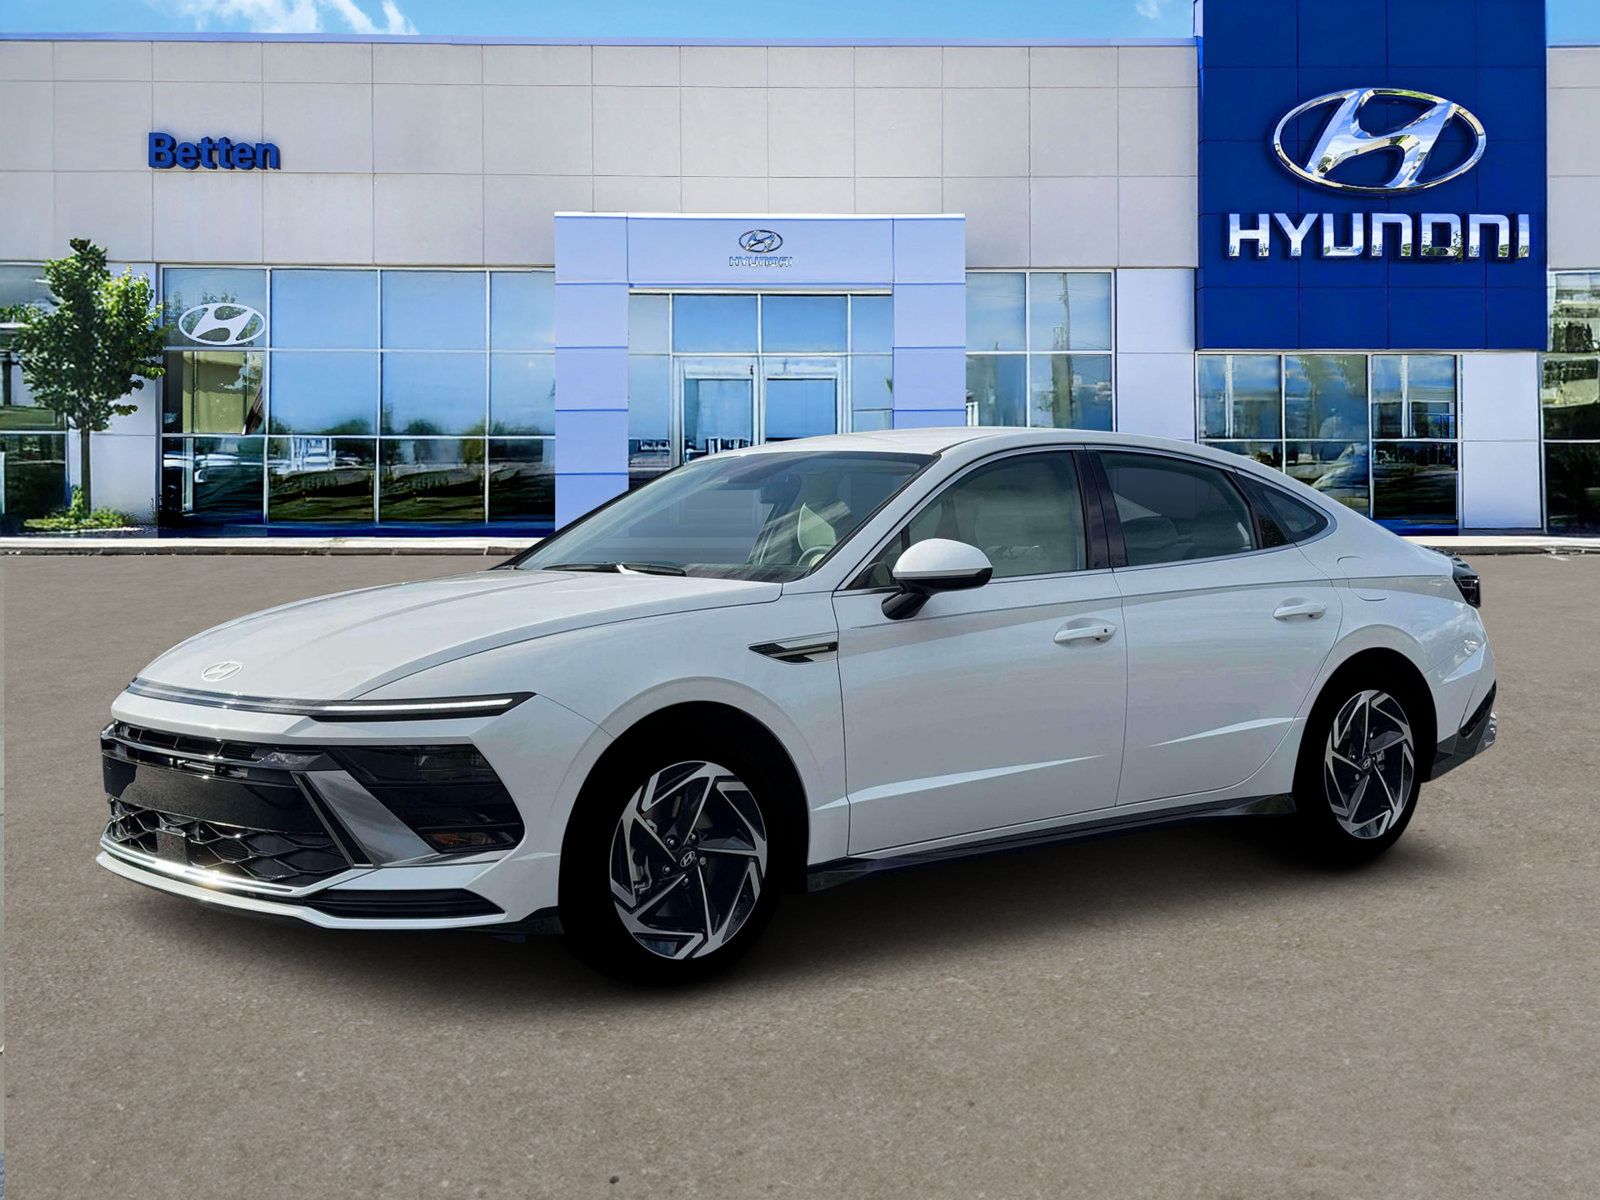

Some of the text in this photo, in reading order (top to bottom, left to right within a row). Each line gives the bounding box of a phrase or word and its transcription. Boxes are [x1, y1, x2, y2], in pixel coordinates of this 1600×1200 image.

[149, 132, 281, 169] Betten
[1228, 212, 1530, 258] HYUNDAI
[729, 256, 793, 267] HYUNDAI
